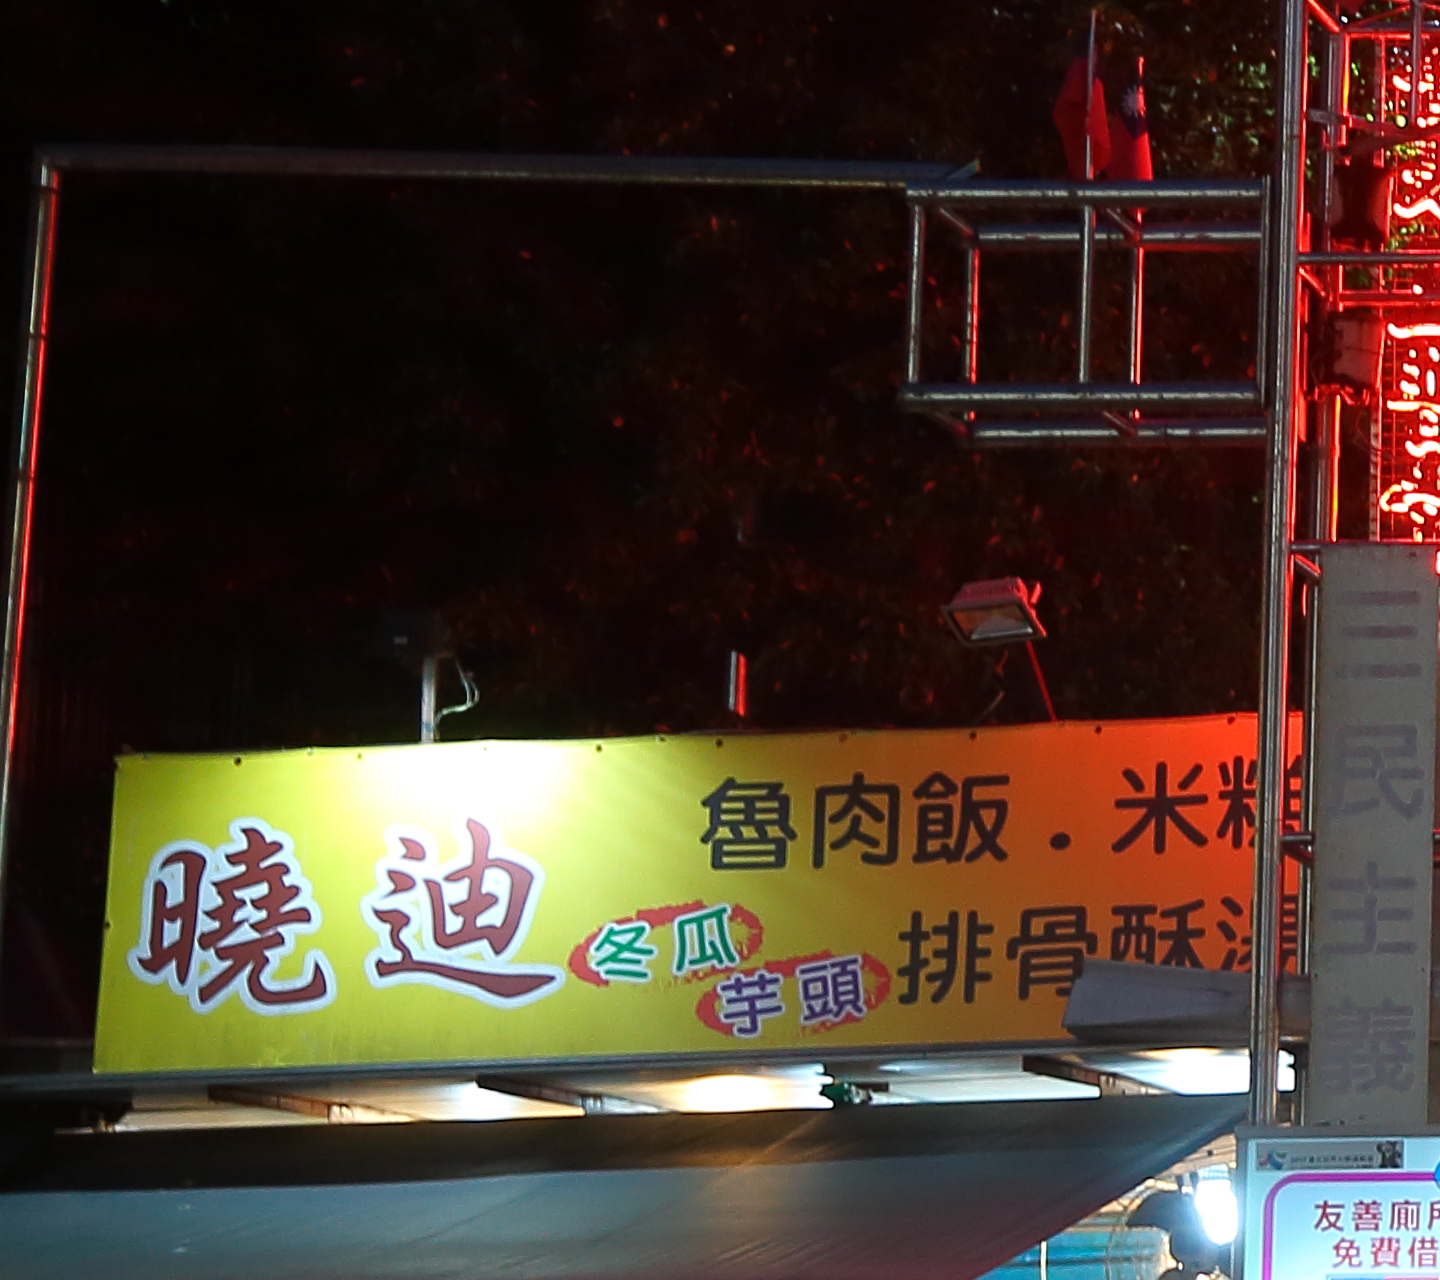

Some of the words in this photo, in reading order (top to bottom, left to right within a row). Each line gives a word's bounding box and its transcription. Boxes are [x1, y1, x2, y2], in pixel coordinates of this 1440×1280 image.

[1320, 588, 1424, 1124] 三民主義
[130, 818, 562, 1010] 曉迪
[591, 902, 744, 983] 冬瓜
[713, 957, 870, 1039] 芋頭
[1332, 1237, 1440, 1268] 免費借
